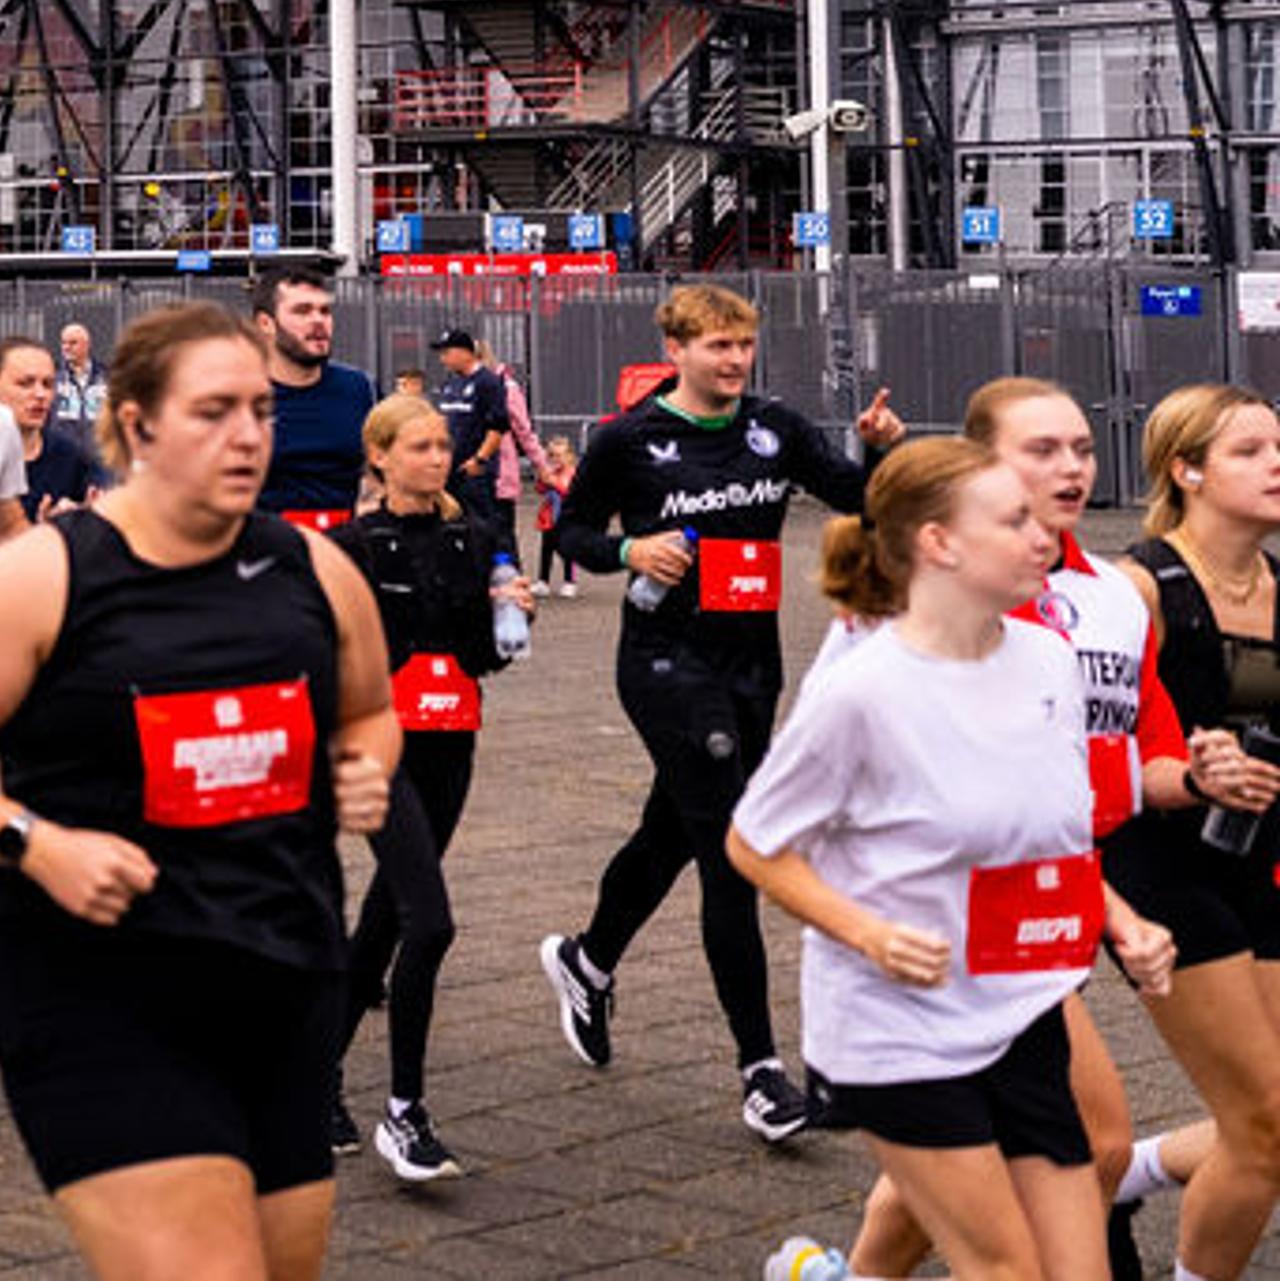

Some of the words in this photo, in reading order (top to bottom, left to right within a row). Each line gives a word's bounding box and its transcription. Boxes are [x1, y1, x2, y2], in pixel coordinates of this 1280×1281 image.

[969, 216, 990, 234] 51
[1141, 210, 1167, 230] 52
[660, 489, 727, 519] Media
